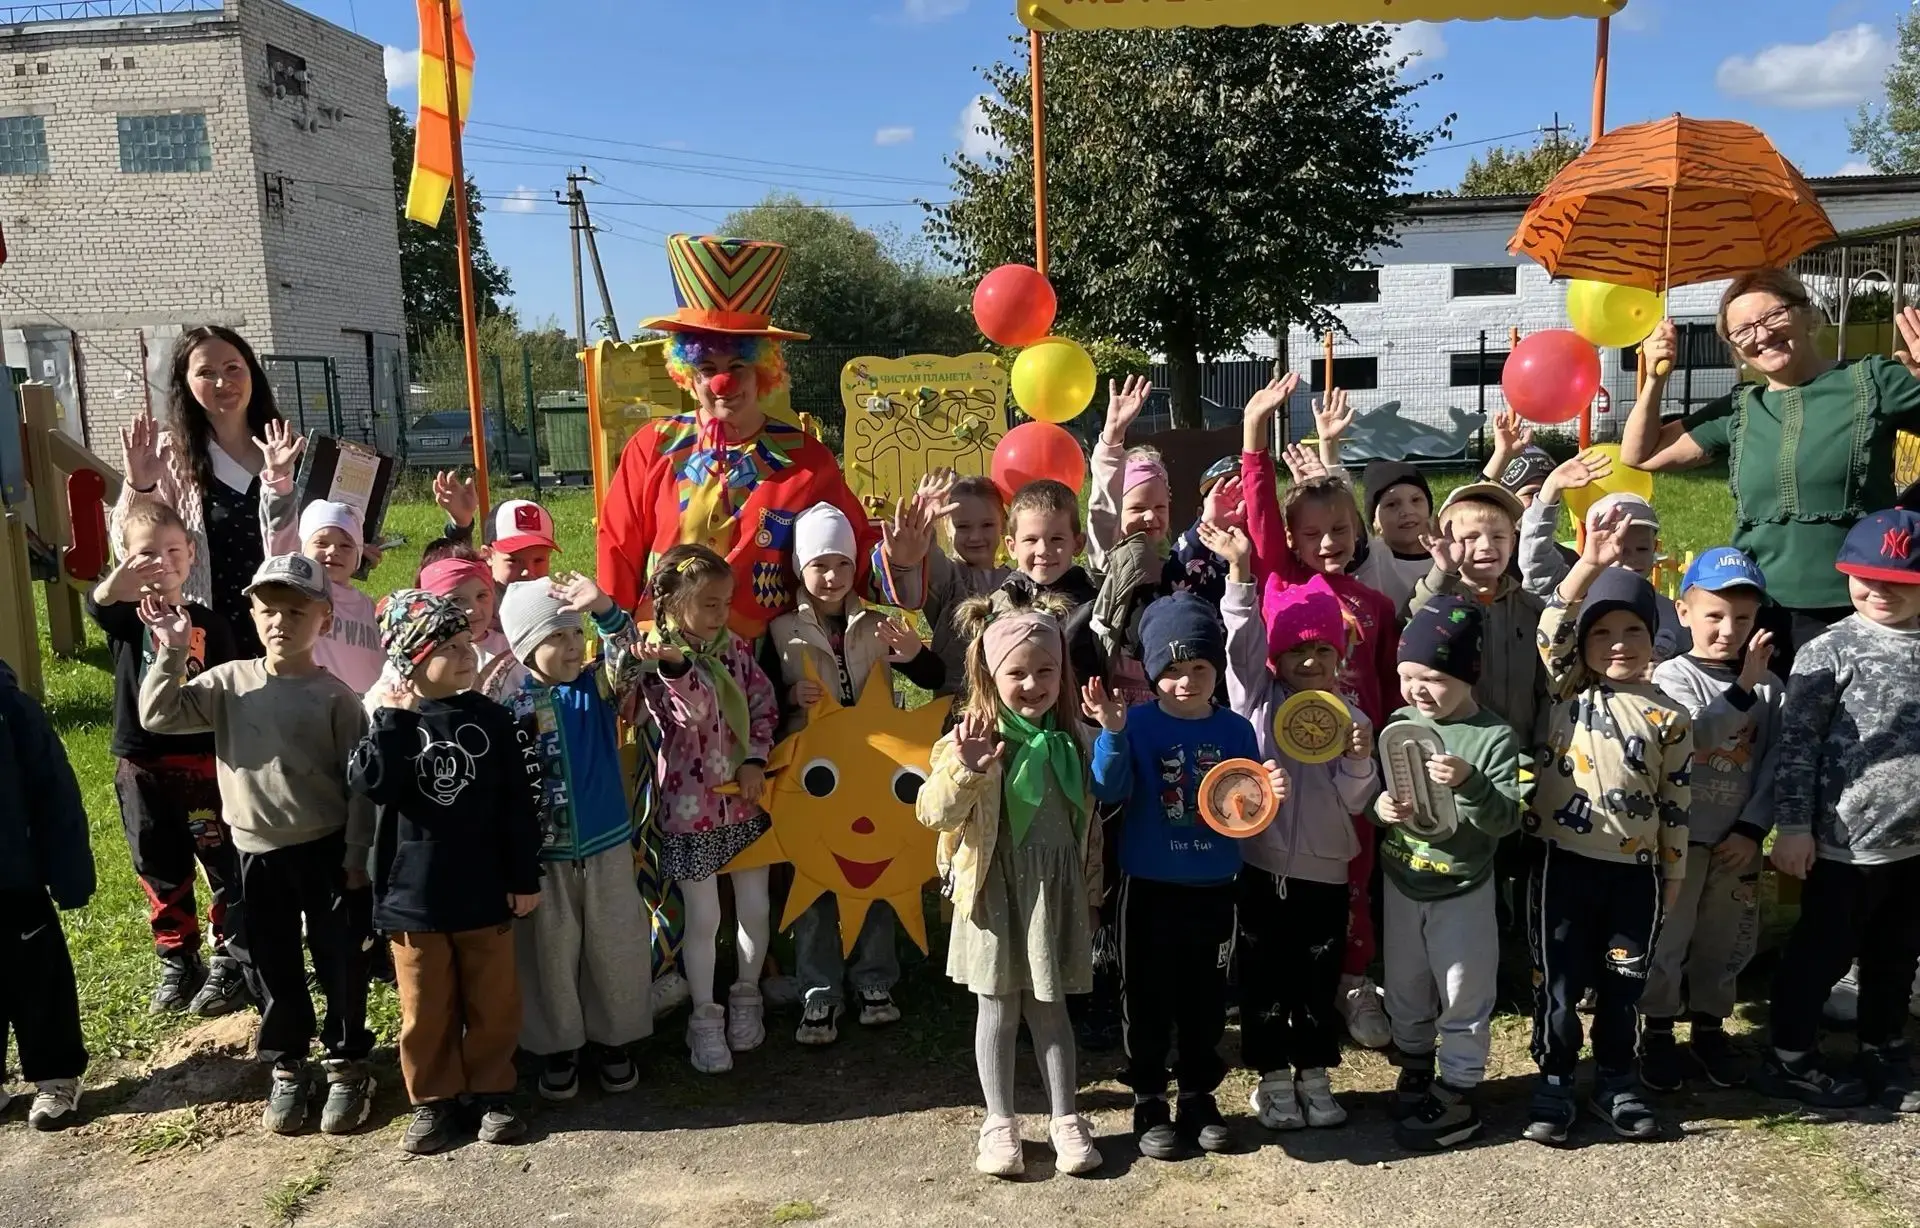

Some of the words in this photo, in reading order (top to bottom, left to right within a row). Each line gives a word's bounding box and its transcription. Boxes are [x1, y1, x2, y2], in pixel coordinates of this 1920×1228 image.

[880, 374, 921, 384] ЧИСТАЯ
[923, 372, 972, 383] ПЛАНЕТА
[1880, 527, 1910, 559] NY
